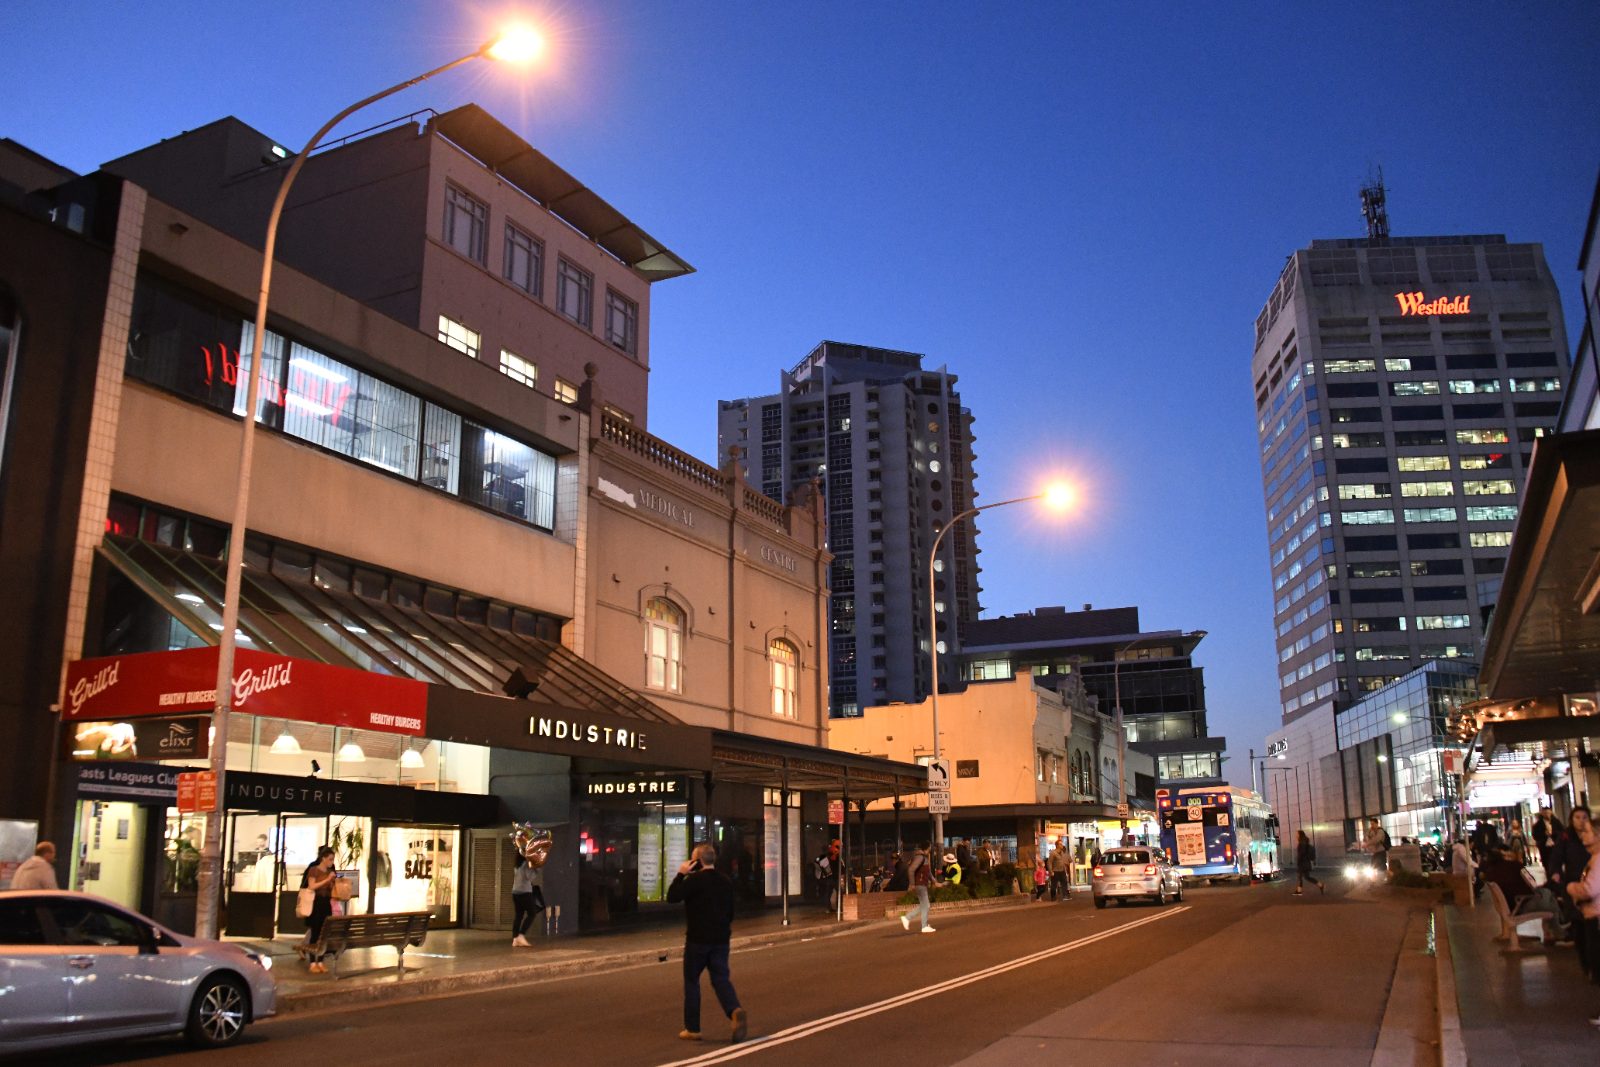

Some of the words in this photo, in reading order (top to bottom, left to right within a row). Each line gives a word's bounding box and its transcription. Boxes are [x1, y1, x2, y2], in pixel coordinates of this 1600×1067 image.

[1395, 291, 1471, 316] Westfield
[639, 489, 695, 528] MEDICAL
[760, 545, 798, 571] CENTRE
[69, 661, 120, 714] Grill'd
[231, 661, 292, 707] Grill'd
[159, 692, 186, 706] HEALTHY
[186, 690, 217, 704] BURGERS
[370, 712, 395, 727] HEALTHY
[395, 717, 422, 730] BURGERS
[159, 730, 194, 748] elixr
[529, 716, 647, 750] INDUSTRIE
[108, 768, 155, 785] Leagues
[229, 784, 345, 804] INDUSTRIE
[588, 781, 676, 794] INDUSTRIE
[1190, 808, 1200, 816] 40
[405, 860, 433, 880] SALE
